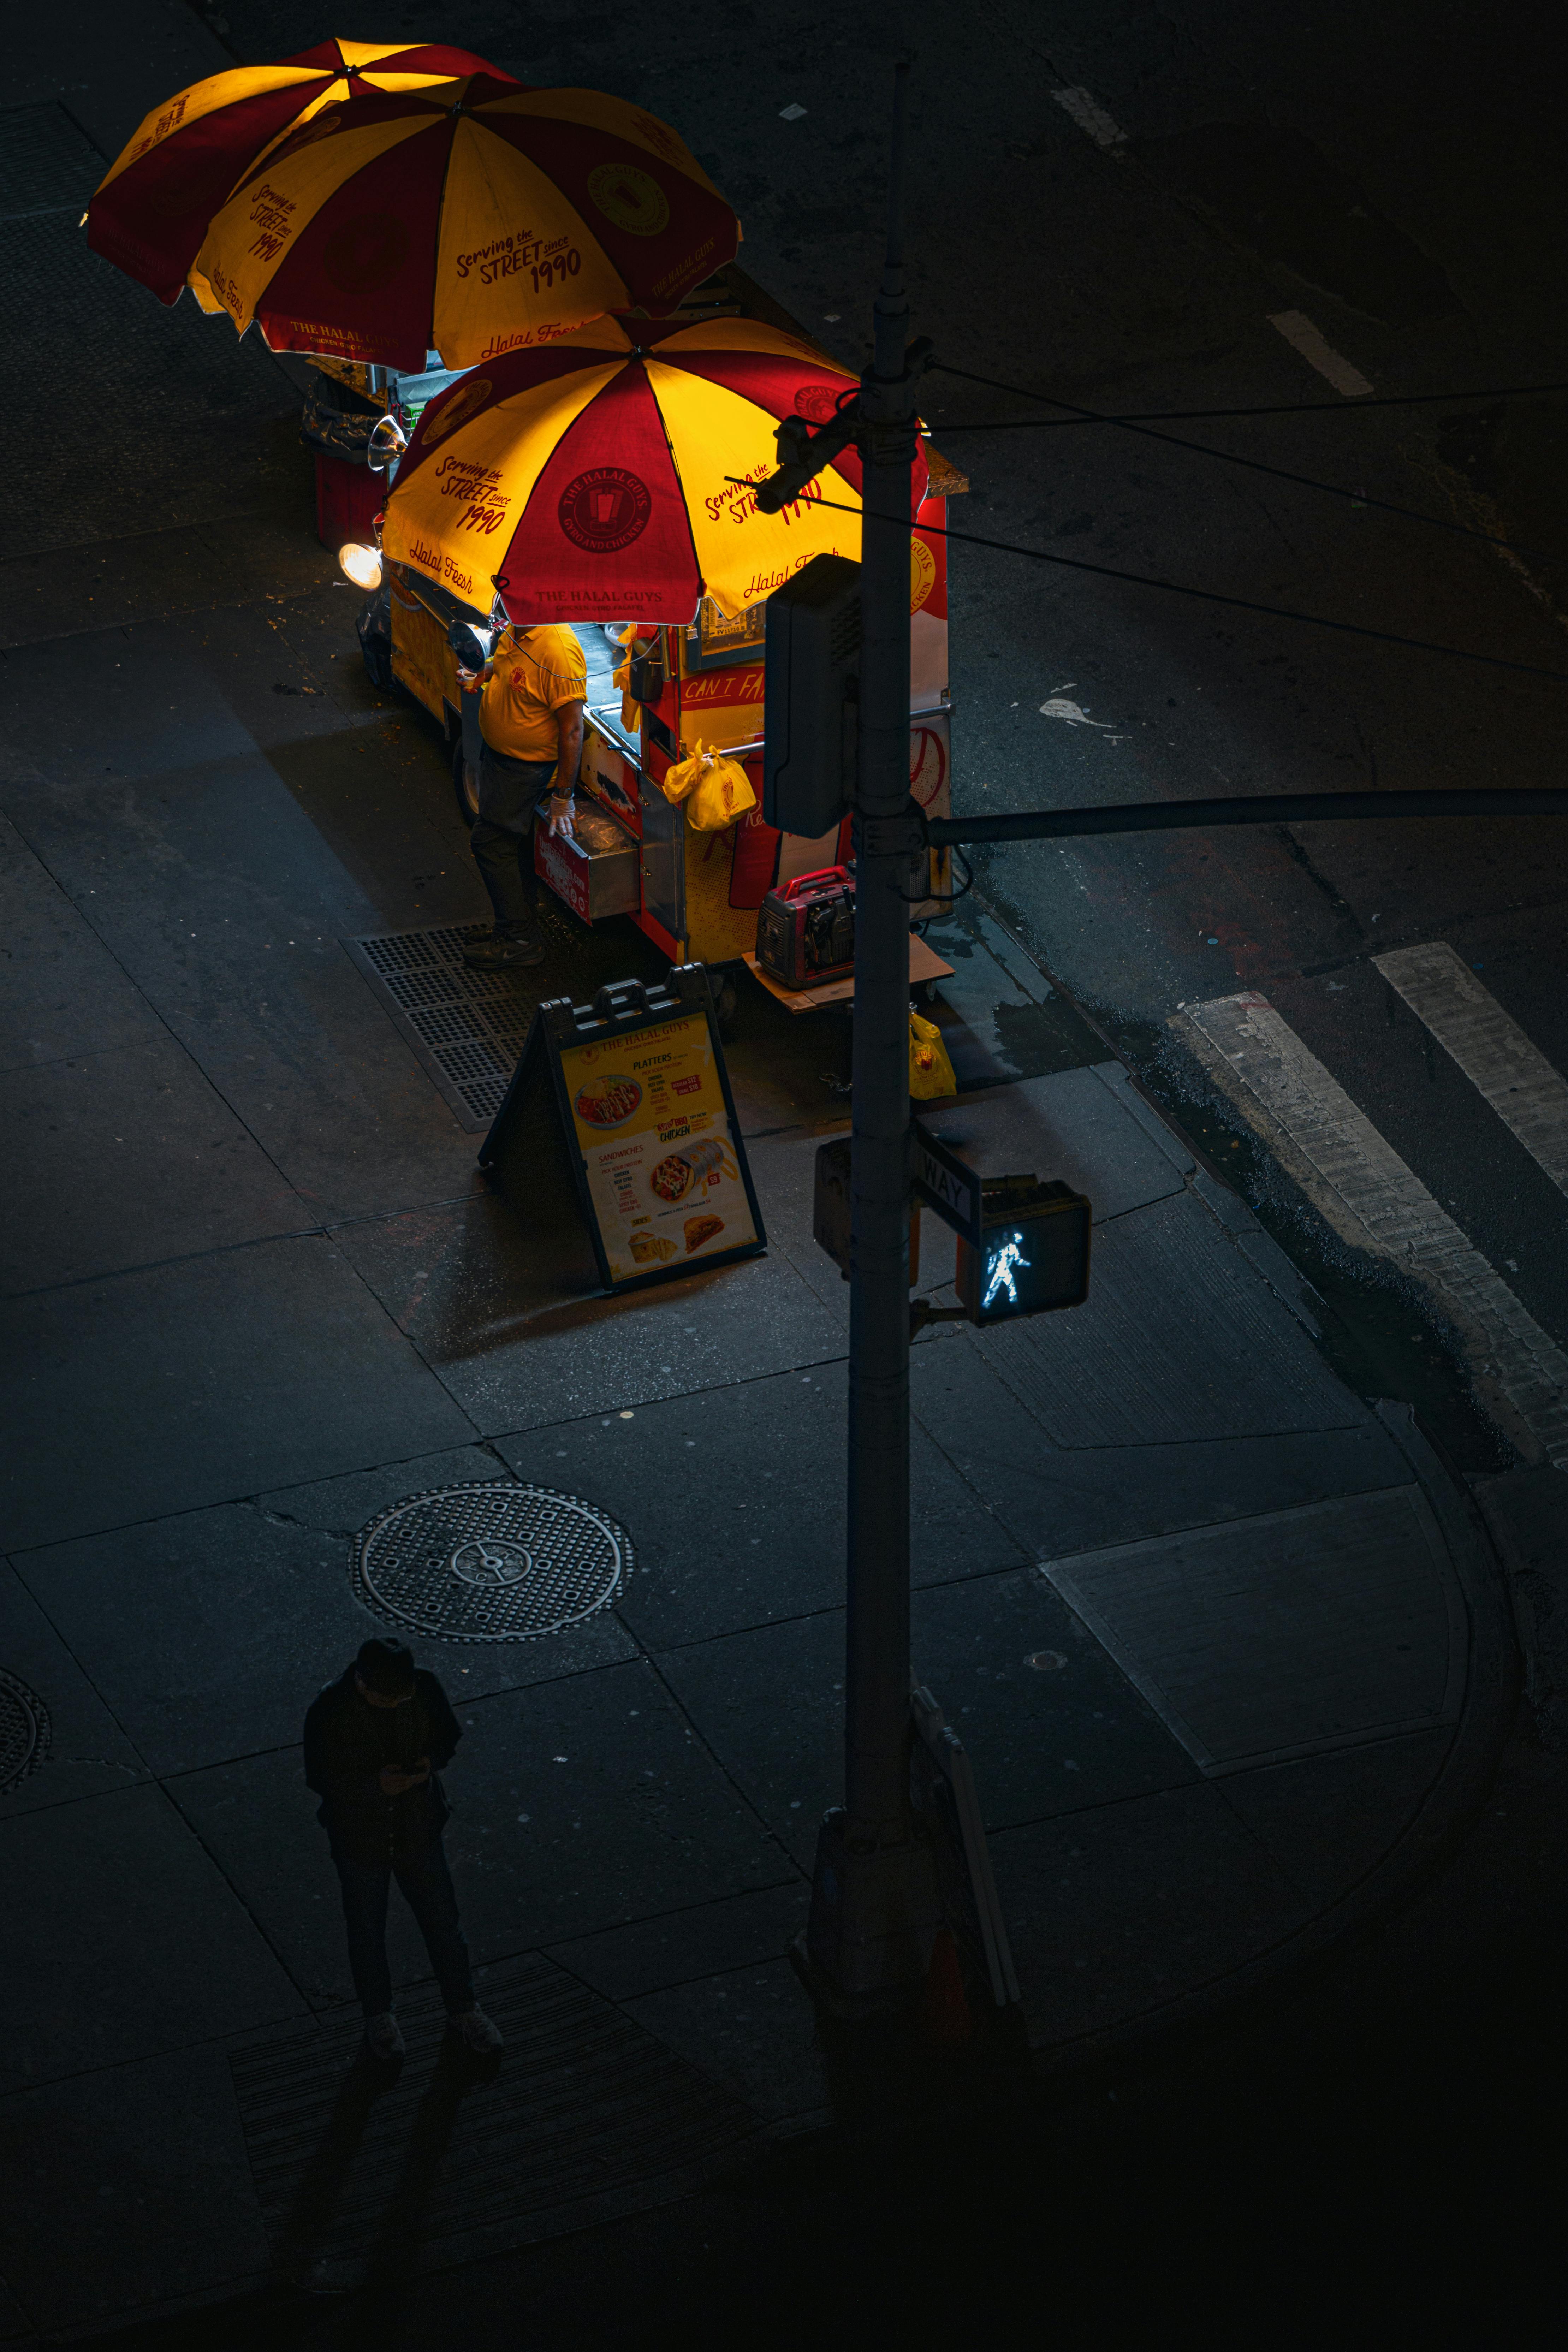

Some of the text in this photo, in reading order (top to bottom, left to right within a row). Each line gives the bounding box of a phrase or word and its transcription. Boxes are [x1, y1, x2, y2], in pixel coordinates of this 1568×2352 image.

[252, 184, 289, 211] Serving
[250, 203, 288, 232] STREET
[248, 232, 284, 262] 1990
[457, 229, 533, 278] Serving the
[480, 236, 569, 284] STREET since
[531, 248, 581, 294] 1990
[290, 321, 399, 348] THE HALAL GUYS
[309, 337, 338, 346] CHICKEN
[481, 331, 533, 359] Halal
[435, 456, 503, 482] Serving the
[441, 476, 512, 505] STREET since
[563, 470, 648, 507] THE HALAL GUYS
[705, 464, 768, 521] Serving the
[456, 504, 505, 535] 1990
[729, 492, 759, 524] STR
[564, 518, 645, 550] GYRO AND CHICKEN
[410, 539, 473, 594] Halal Fresh
[910, 541, 932, 569] GUYS
[743, 566, 792, 598] Halal
[535, 591, 662, 602] THE HALAL GUYS
[739, 672, 764, 700] FA
[600, 1020, 689, 1051] THE HALAL GUYS
[633, 1053, 672, 1070] PLATTERS
[660, 1124, 690, 1142] CHICKEN
[675, 1116, 688, 1126] BBQ
[599, 1144, 643, 1162] SANDWICHES
[624, 1159, 642, 1168] PROTEIN
[614, 1170, 630, 1178] CHICKEN
[924, 1153, 962, 1208] WAY
[632, 1216, 648, 1225] SIDES
